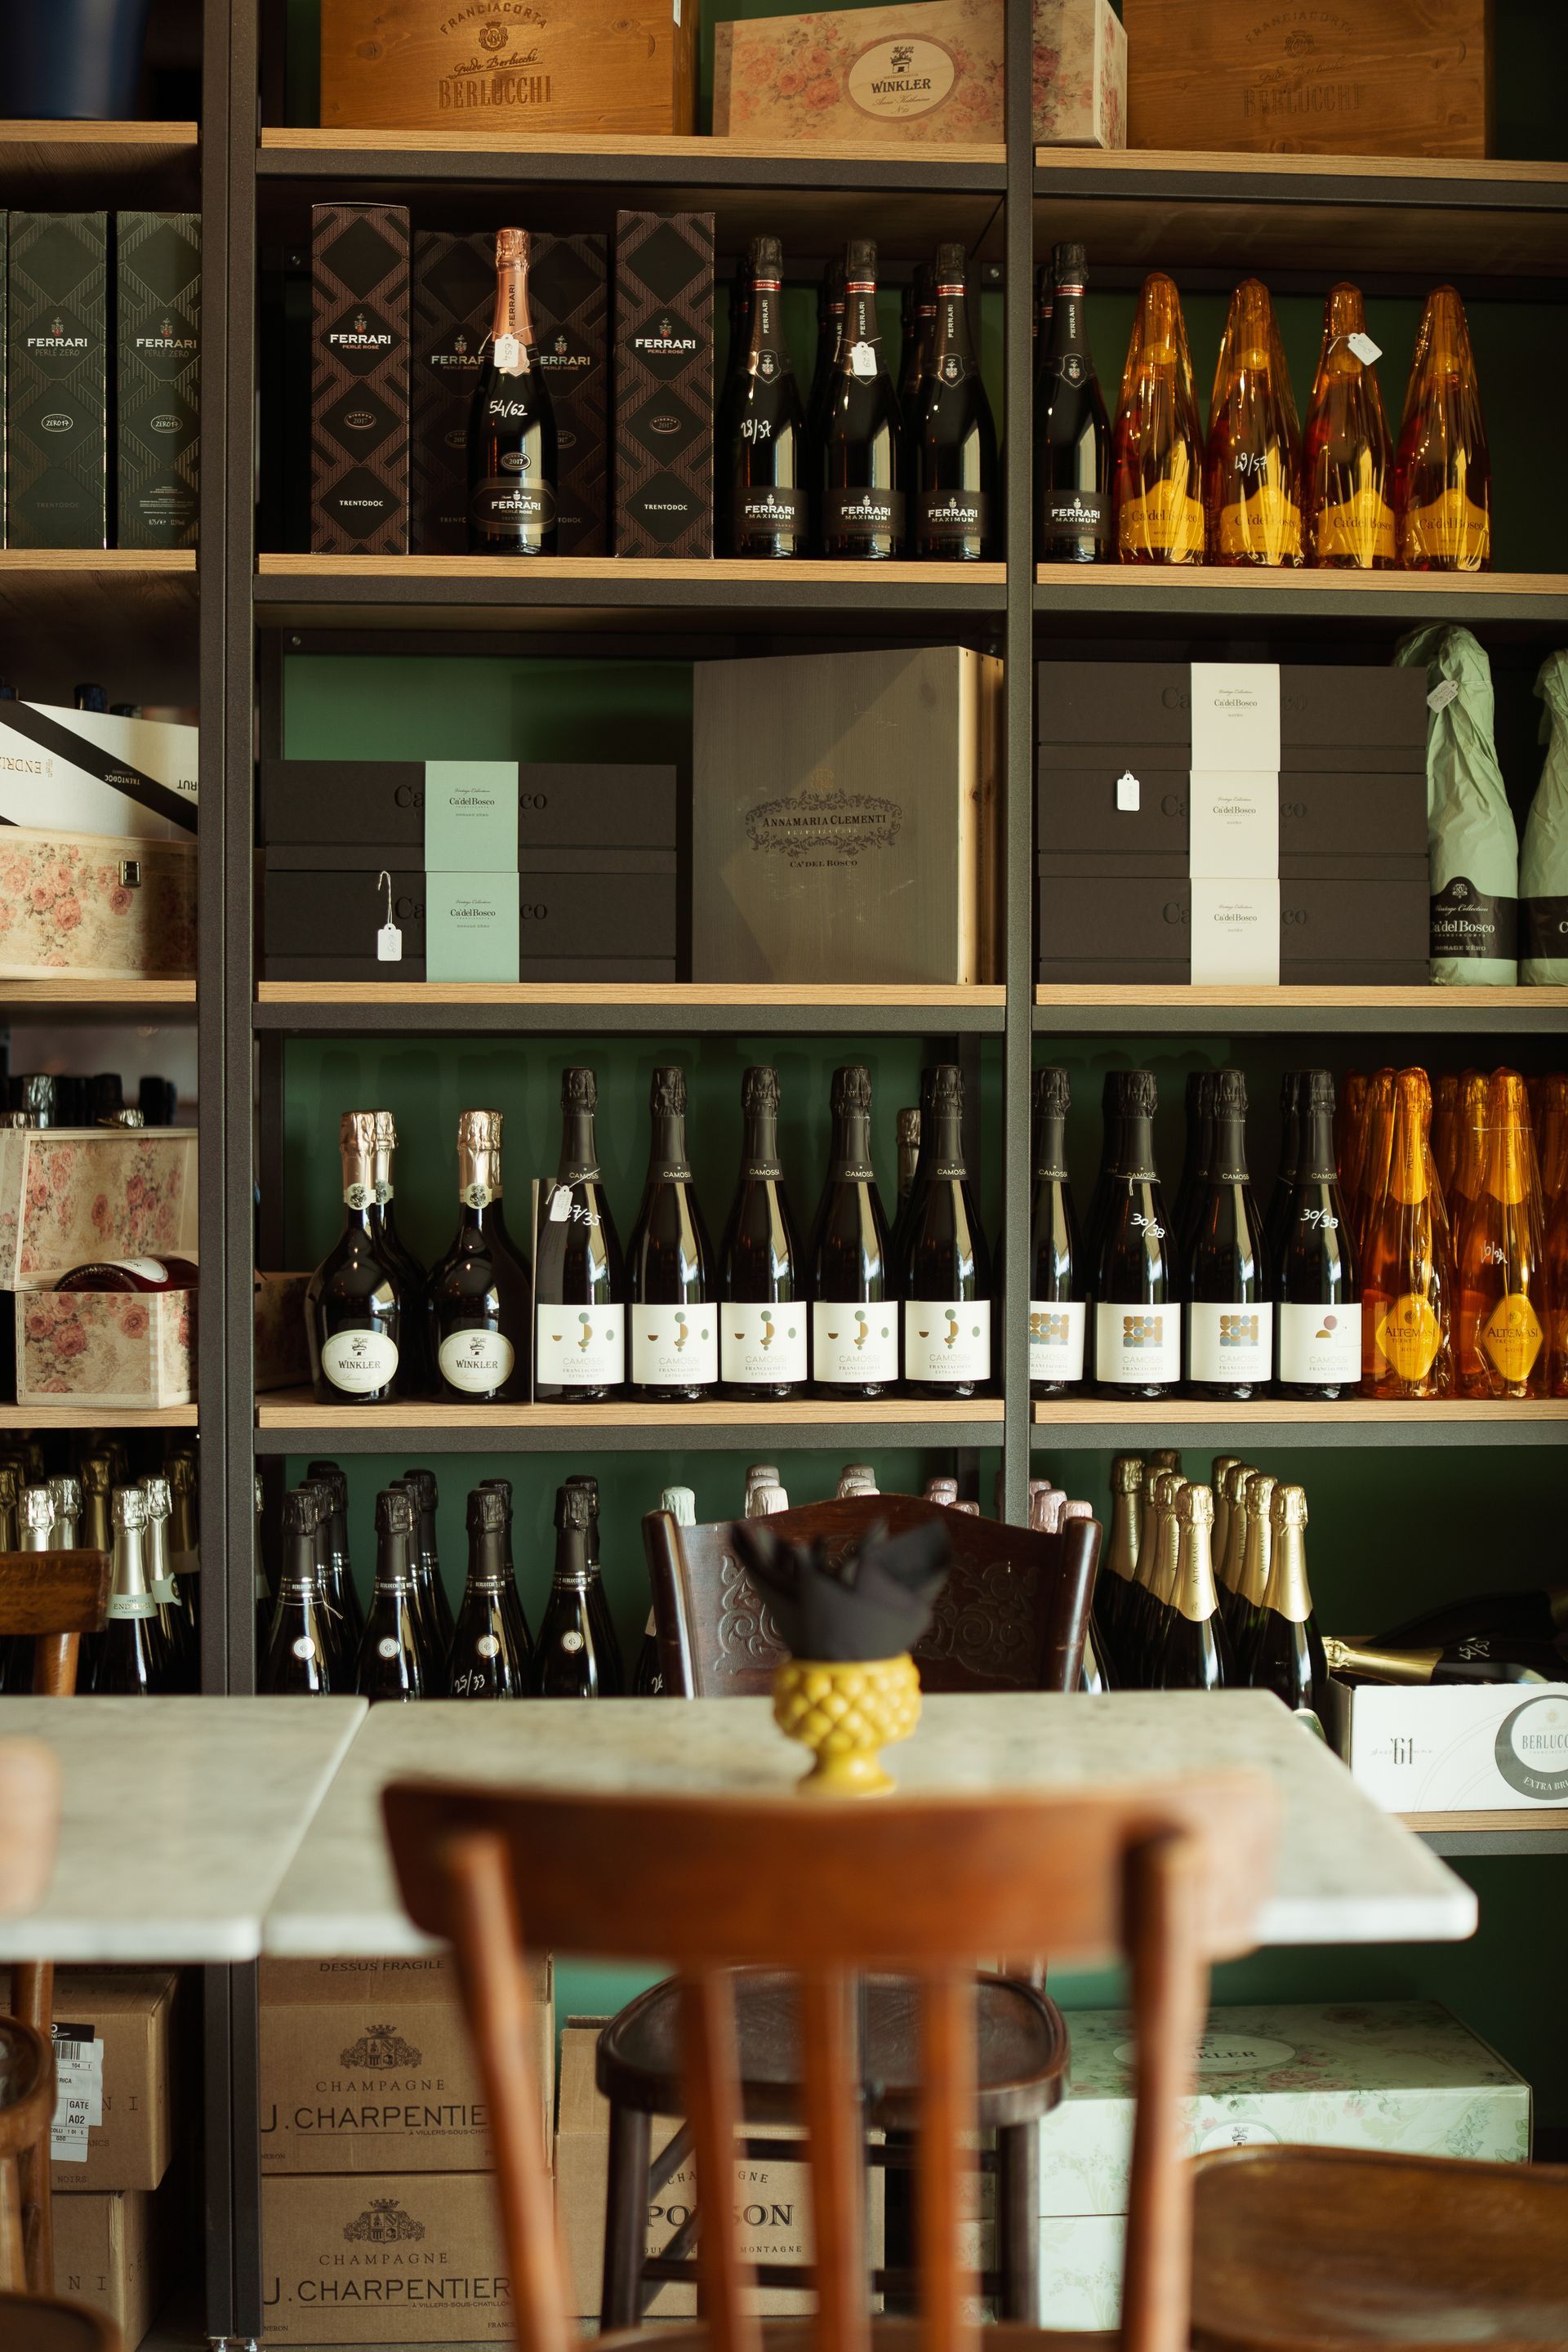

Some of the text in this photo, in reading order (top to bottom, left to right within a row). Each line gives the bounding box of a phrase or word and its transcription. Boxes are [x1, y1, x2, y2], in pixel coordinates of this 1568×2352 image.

[440, 2, 547, 34] FRANCIACORTA
[871, 78, 932, 93] WINKLER
[439, 76, 551, 109] BERLUCCHI
[27, 338, 87, 347] FERRARI
[136, 338, 196, 348] FERRARI
[330, 334, 391, 345] FERRARI
[635, 339, 696, 349] FERRARI
[59, 349, 80, 357] ZERO
[169, 350, 189, 358] ZERO
[431, 355, 485, 365] FERRAR
[541, 356, 590, 365] ERRARI
[489, 400, 528, 417] 54/62
[1234, 452, 1267, 476] 49/57
[491, 501, 541, 510] FERRARI
[745, 505, 795, 514] FERRARI
[841, 506, 891, 516] FERRARI
[928, 508, 978, 518] FERRARI
[1051, 508, 1100, 519] FERRARI
[105, 774, 140, 785] TRENTODOC
[177, 779, 199, 791] RUT
[763, 814, 886, 827] ANNAMARIA CLEMENTI
[1458, 903, 1488, 912] Collection
[1431, 920, 1494, 933] a'del Bosco
[569, 1172, 599, 1180] CAMOSS
[1039, 1169, 1067, 1177] CAMOSS
[1300, 1208, 1339, 1230] 30/38
[1130, 1214, 1165, 1239] 30/38
[1385, 1326, 1436, 1337] ALTEMASI
[1487, 1327, 1538, 1337] ALTEMASI
[338, 1360, 381, 1370] WINKLER
[456, 1360, 498, 1369] WINKLER
[454, 1669, 485, 1696] 25/33
[1522, 1734, 1568, 1749] BERLUCC
[1523, 1775, 1568, 1790] EXTRA BRU
[319, 1960, 445, 1972] DESSUS FRAGILE
[316, 2079, 445, 2092] CHAMPAGNE
[69, 2100, 89, 2109] GATE
[68, 2115, 85, 2125] A02
[667, 2170, 768, 2185] CHAGNE
[319, 2252, 448, 2265] CHAMPAGNE
